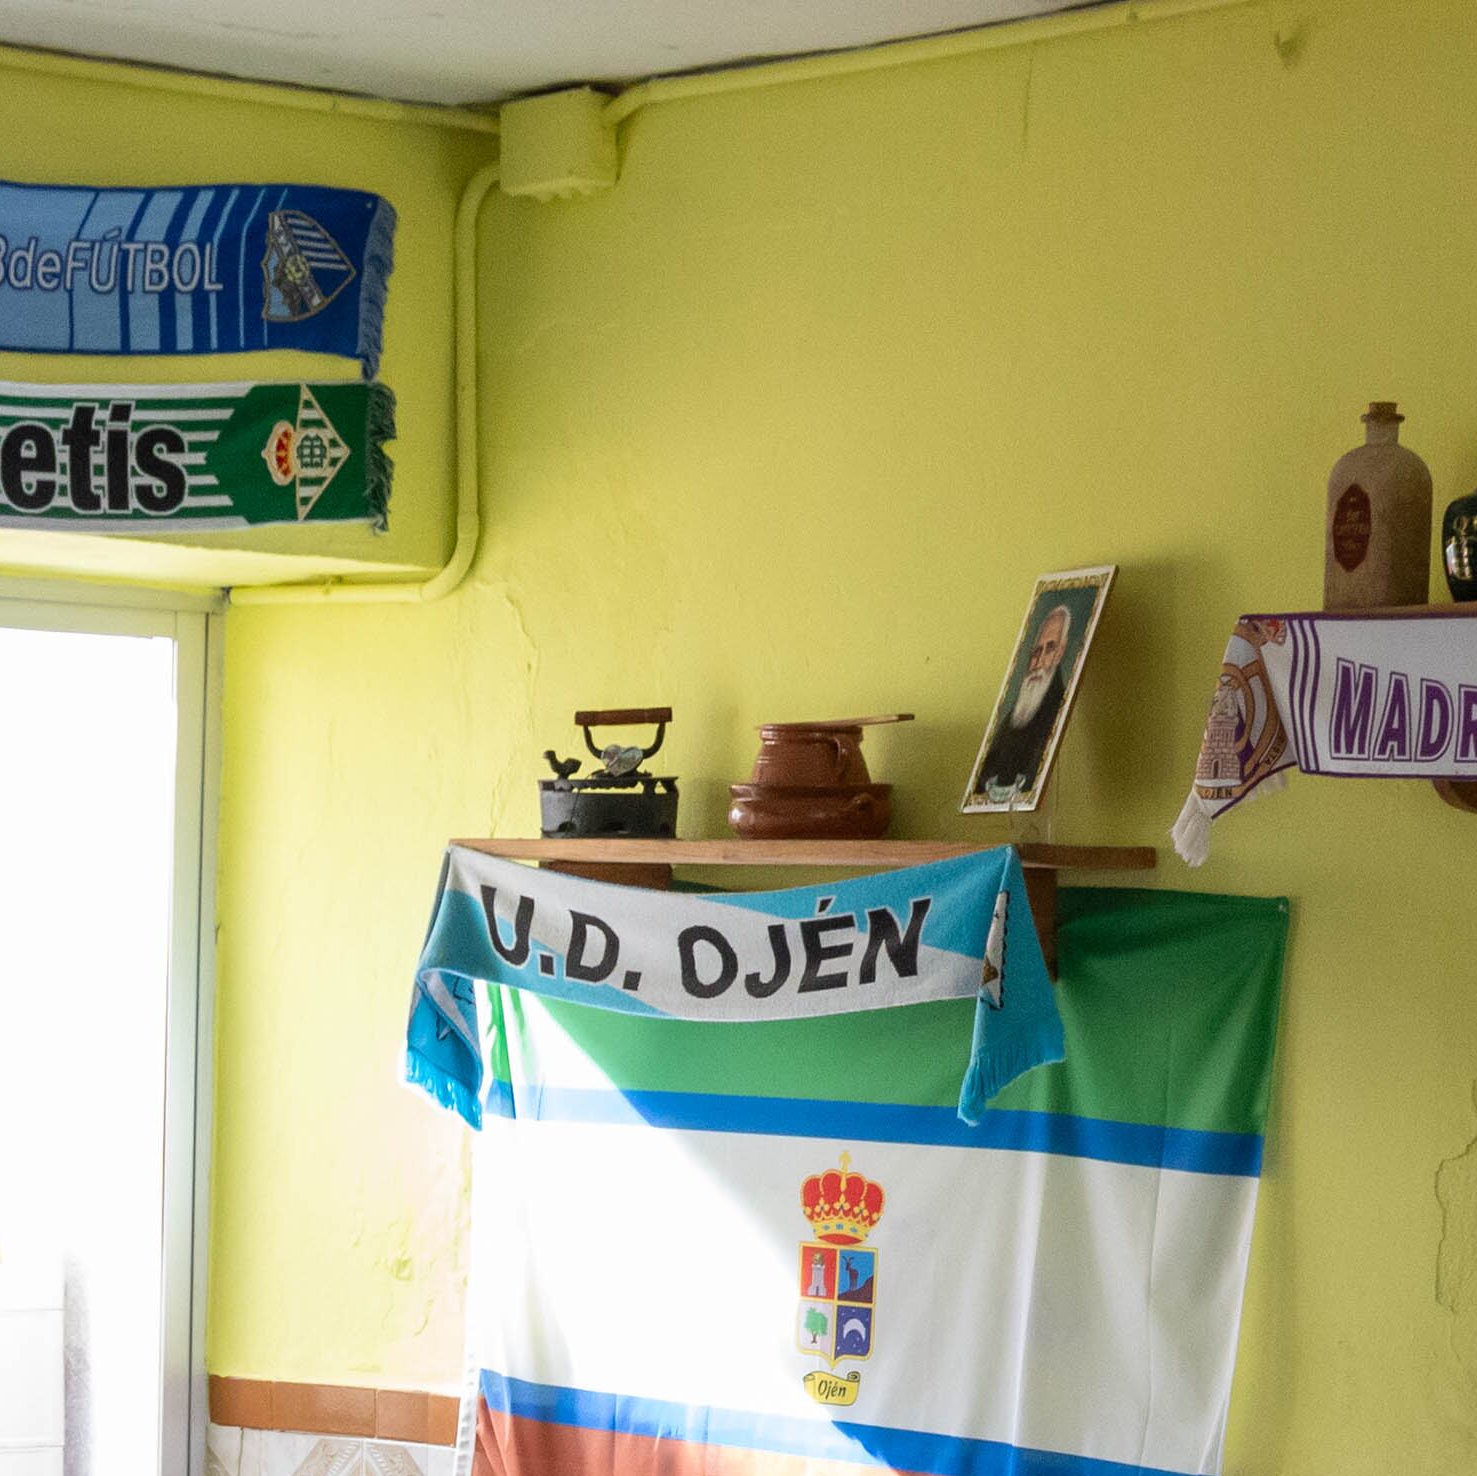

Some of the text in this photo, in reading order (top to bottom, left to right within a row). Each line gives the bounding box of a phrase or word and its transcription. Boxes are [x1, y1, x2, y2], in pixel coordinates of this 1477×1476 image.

[478, 883, 932, 999] U.D. OJÉN
[815, 1377, 849, 1404] Ojén
